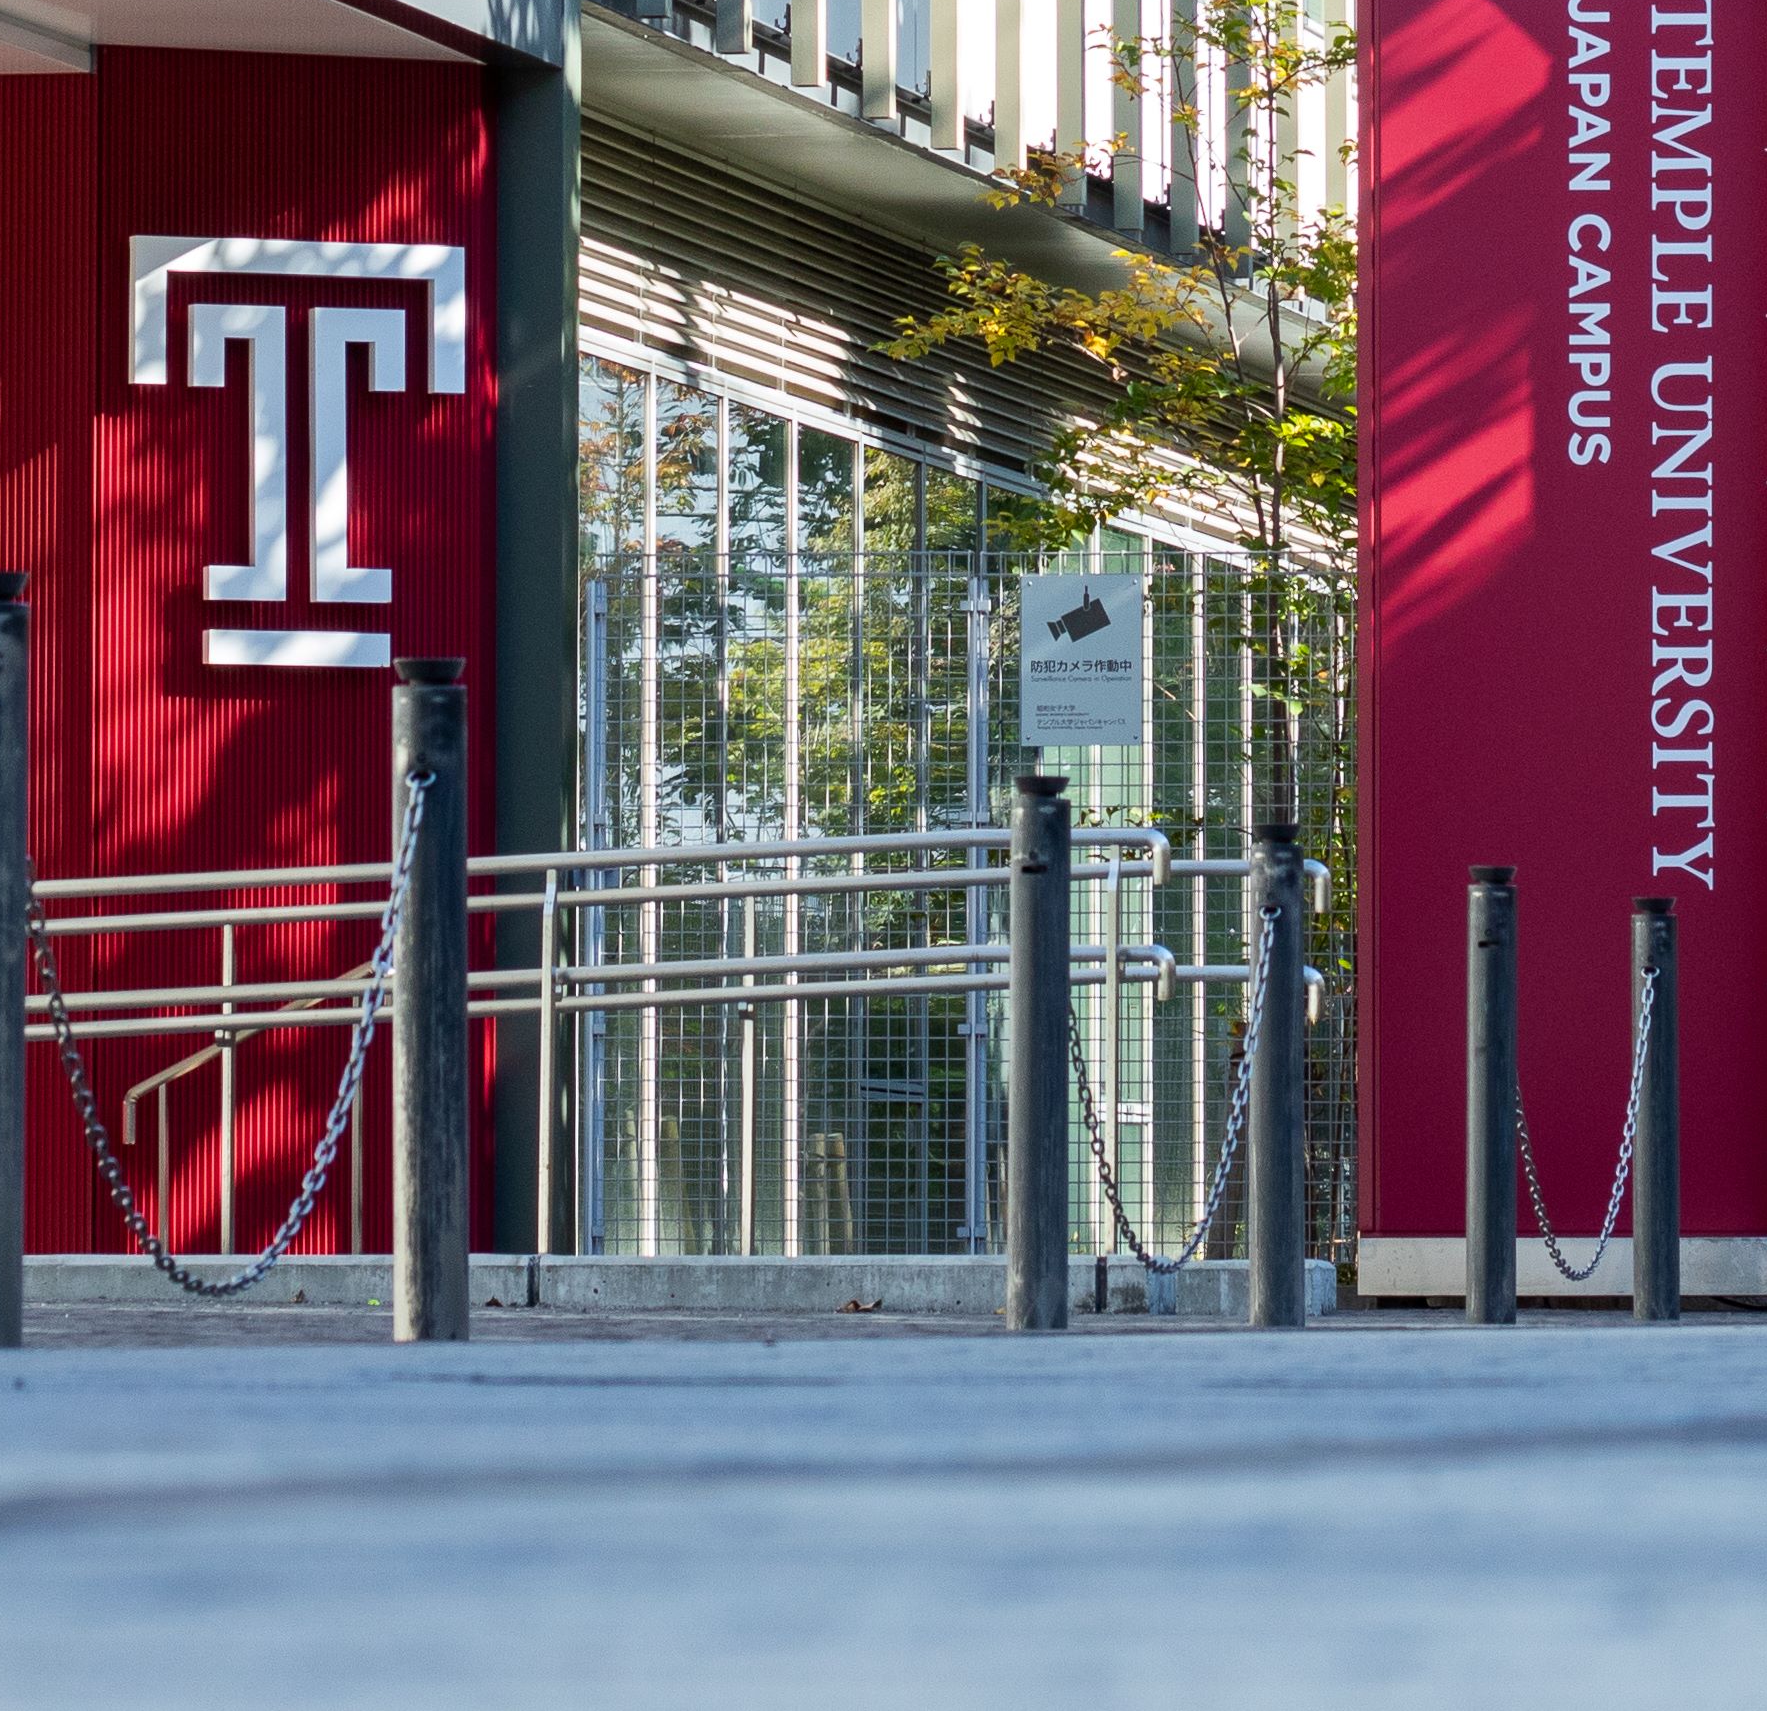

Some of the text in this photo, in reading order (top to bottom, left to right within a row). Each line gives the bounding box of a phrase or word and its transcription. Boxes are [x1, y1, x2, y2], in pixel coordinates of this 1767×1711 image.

[129, 235, 466, 668] T
[1567, 213, 1612, 466] CAMPUS
[1030, 659, 1132, 673] 防犯カメラ作動中
[1650, 354, 1715, 890] UNIVERSITY
